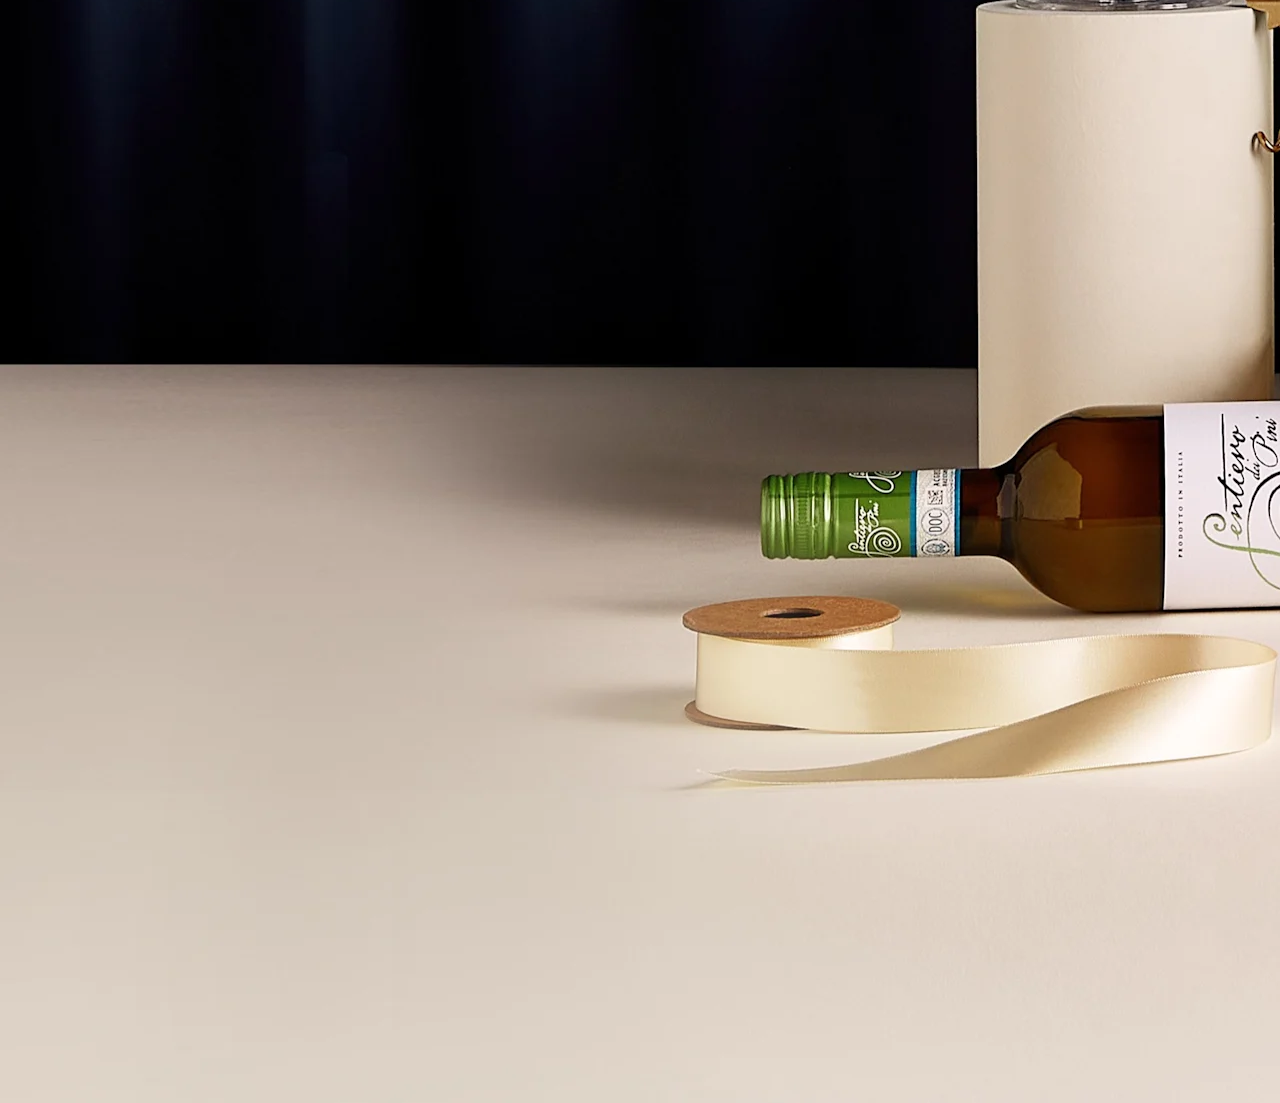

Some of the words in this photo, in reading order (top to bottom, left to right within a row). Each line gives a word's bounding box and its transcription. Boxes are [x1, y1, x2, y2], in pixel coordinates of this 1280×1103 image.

[1248, 415, 1278, 467] Pini
[1178, 489, 1183, 500] IN
[928, 512, 942, 533] DOC
